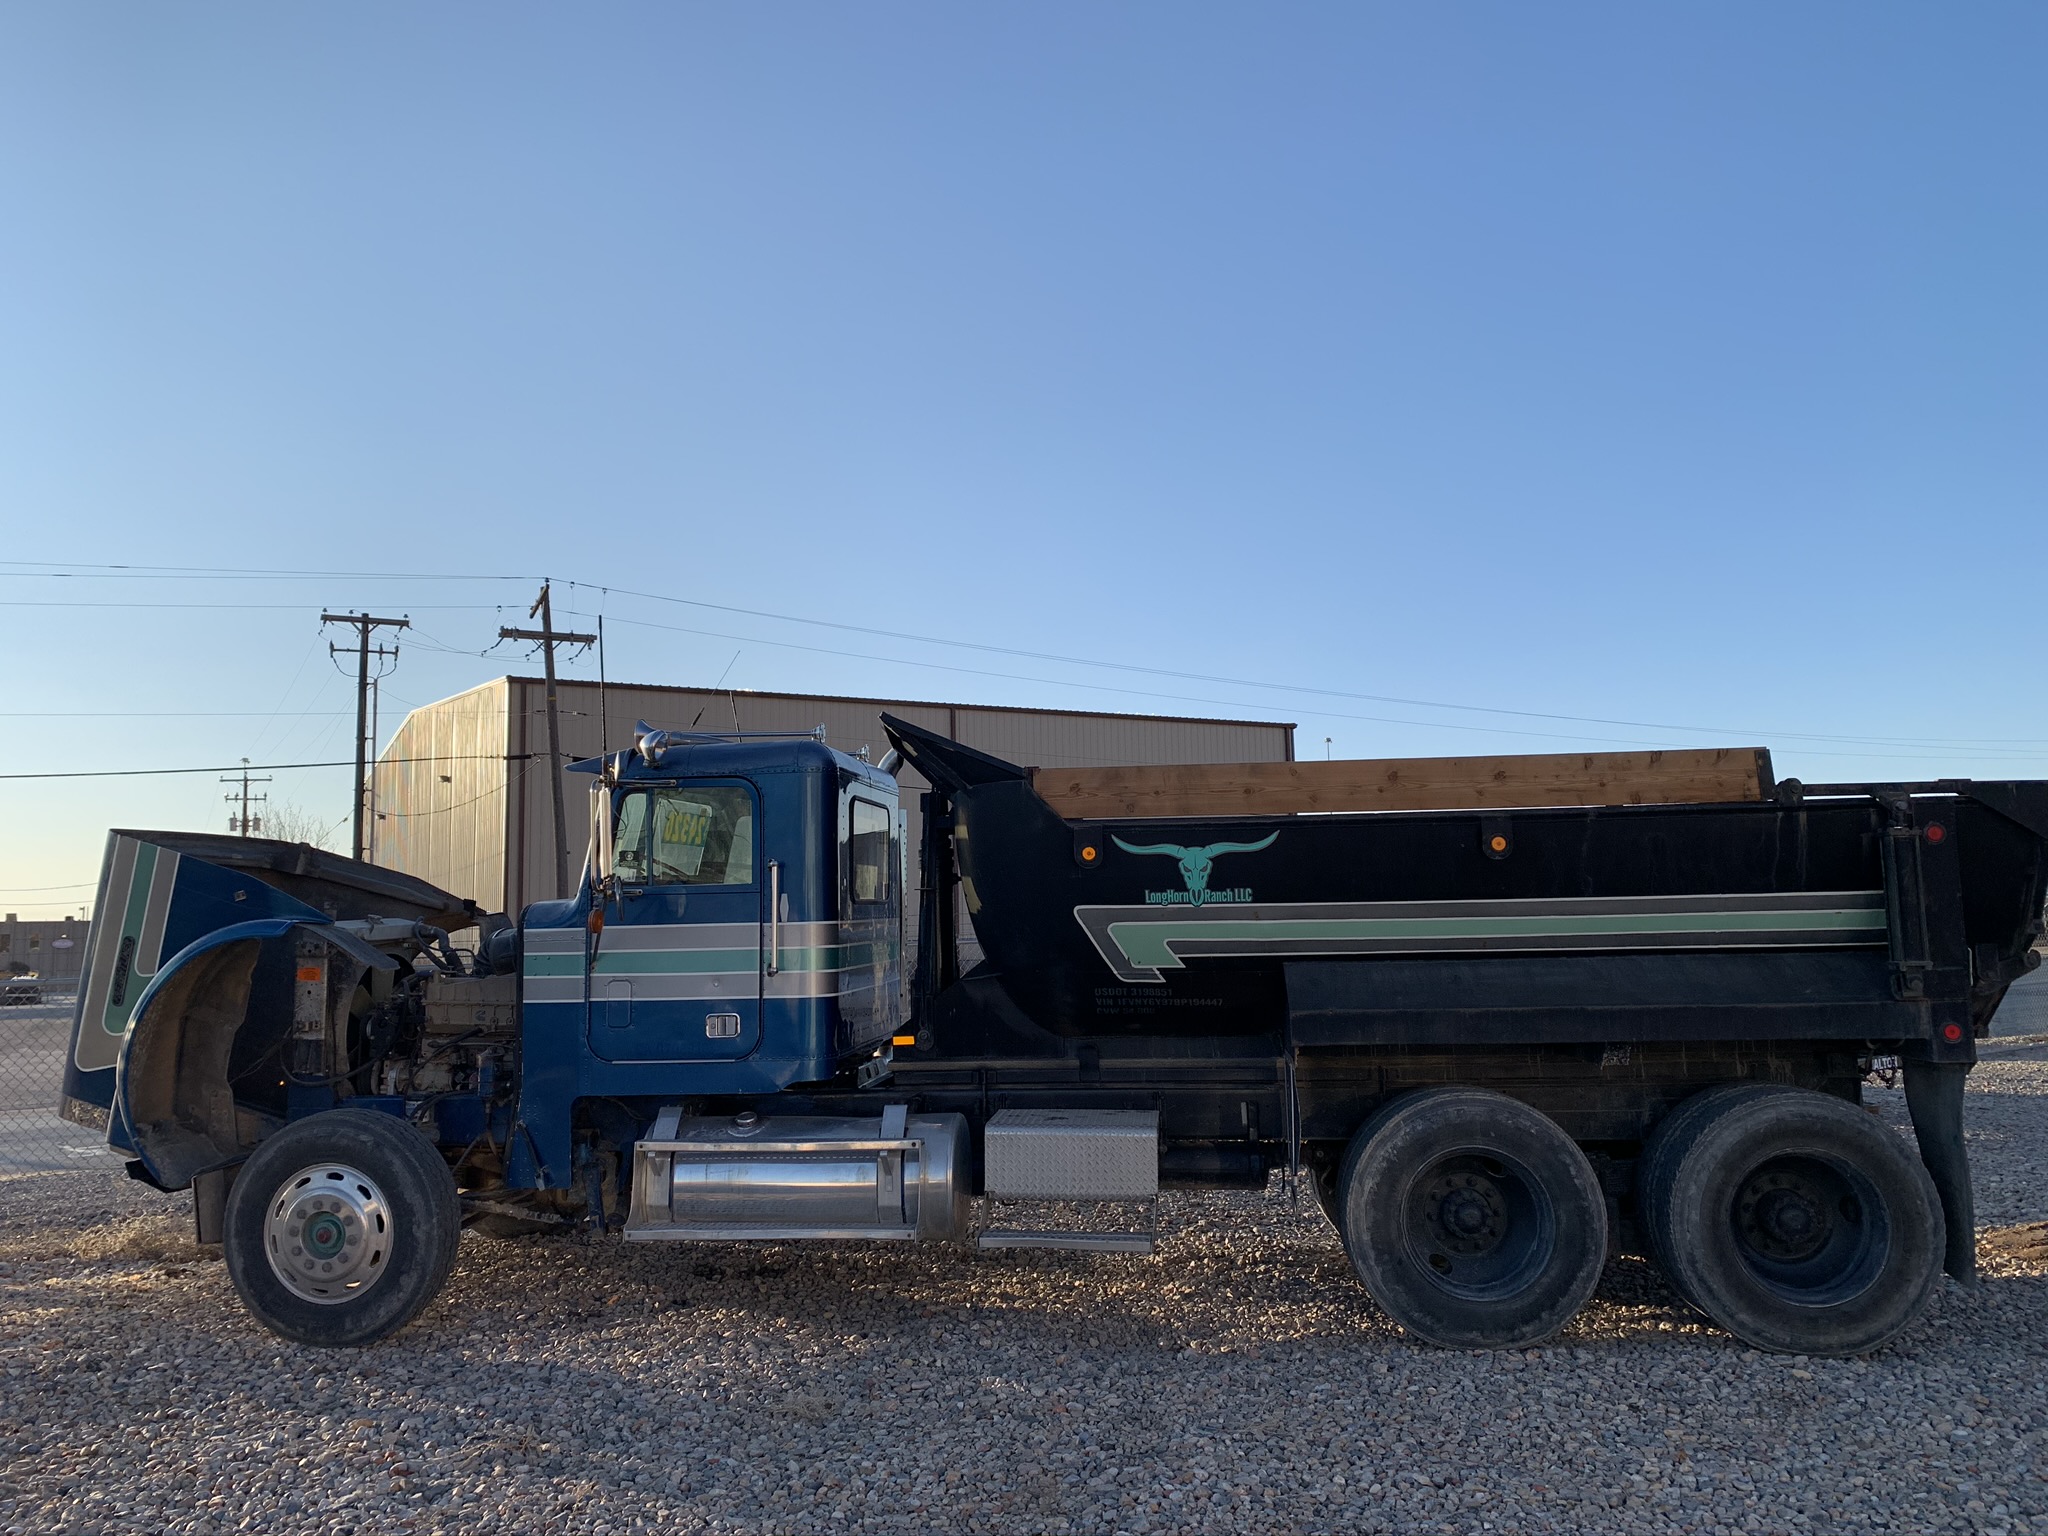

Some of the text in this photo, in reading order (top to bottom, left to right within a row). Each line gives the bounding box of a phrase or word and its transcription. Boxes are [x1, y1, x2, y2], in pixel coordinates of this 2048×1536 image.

[1144, 887, 1253, 906] LongHorn Ranch LLC
[1094, 987, 1128, 996] USDOT
[1095, 997, 1113, 1006] VIN
